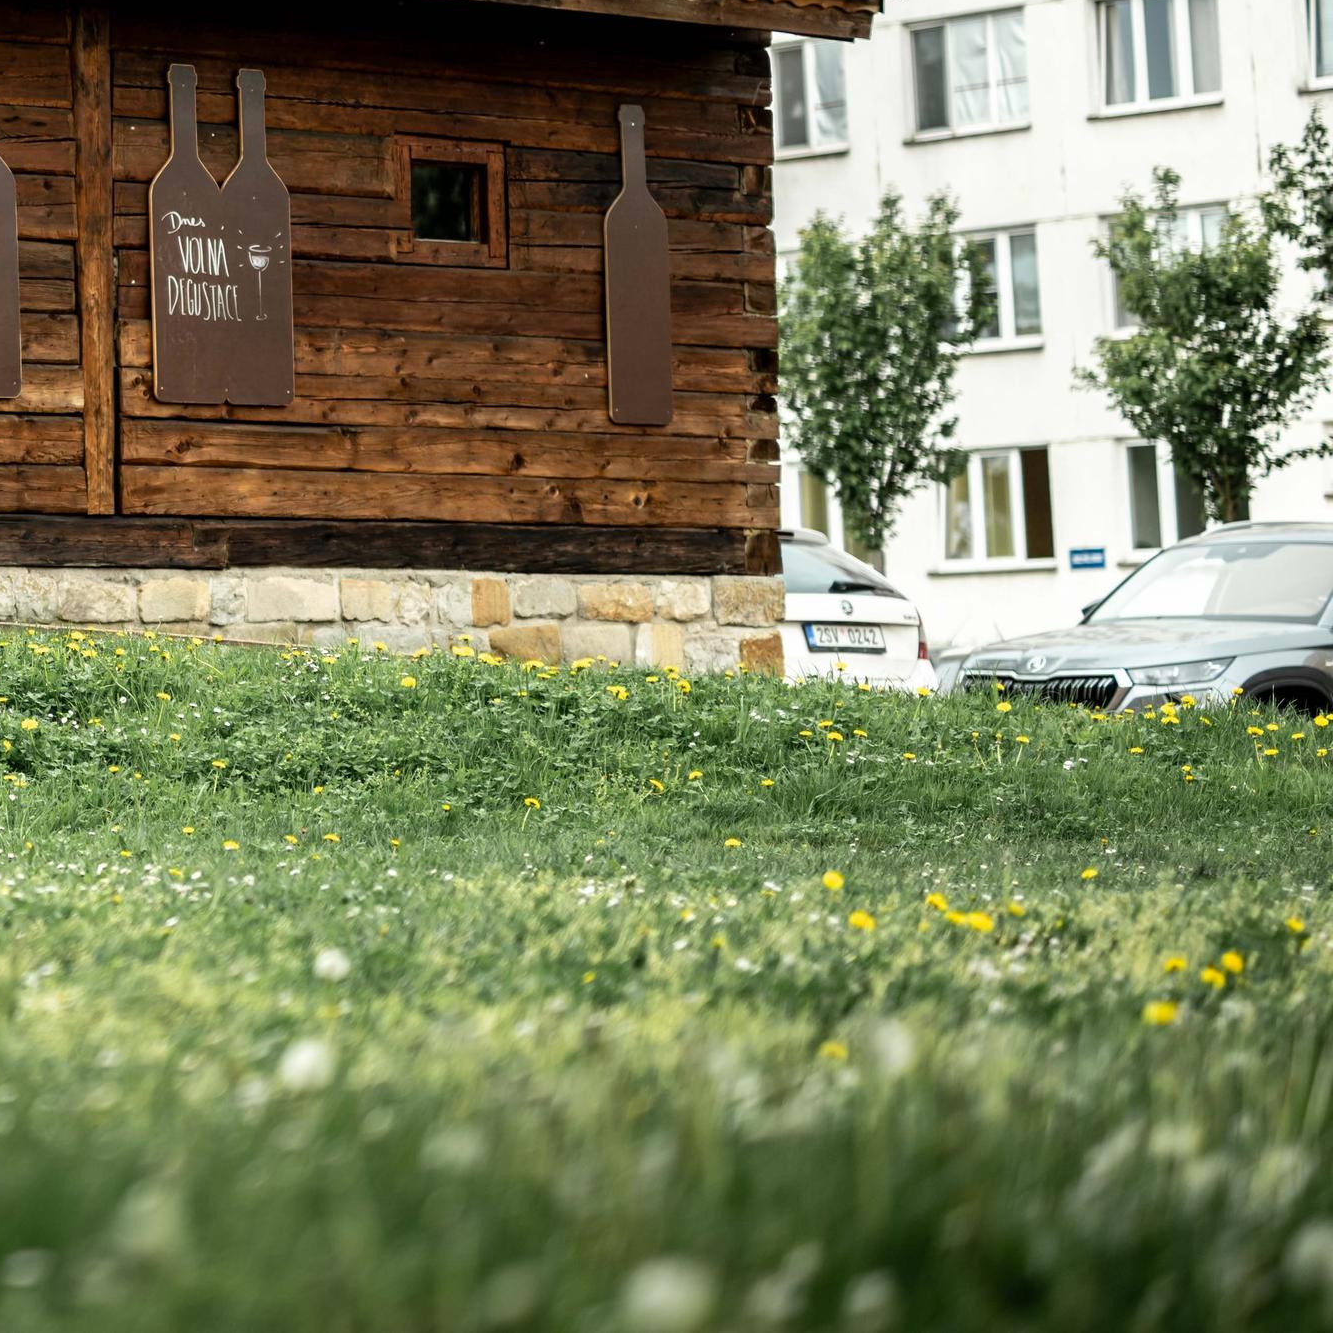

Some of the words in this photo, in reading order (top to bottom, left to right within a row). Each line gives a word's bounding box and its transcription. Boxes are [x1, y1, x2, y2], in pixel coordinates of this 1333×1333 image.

[161, 211, 206, 234] Dnes
[168, 275, 242, 322] DEGUSTACE
[816, 627, 839, 644] 2SV
[847, 628, 878, 645] 0242
